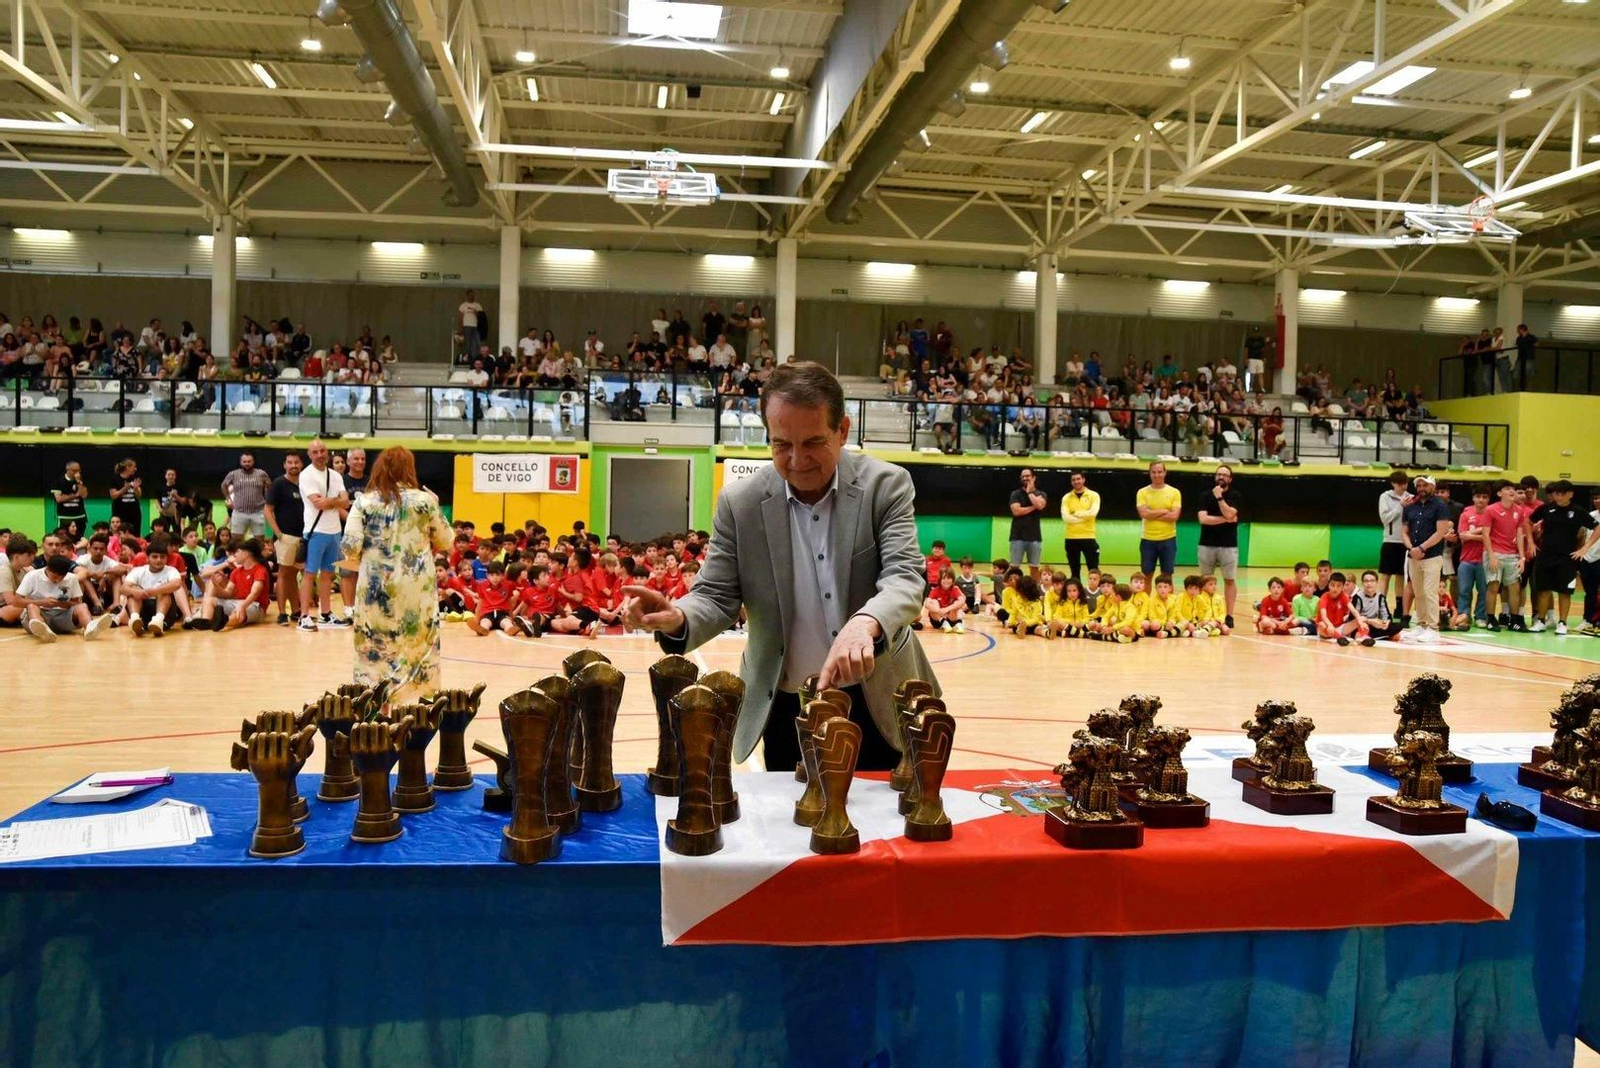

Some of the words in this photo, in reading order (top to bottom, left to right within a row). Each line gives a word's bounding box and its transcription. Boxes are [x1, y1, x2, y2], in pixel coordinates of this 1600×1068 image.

[481, 462, 539, 472] CONCELLO
[731, 465, 760, 474] CONC
[488, 473, 502, 482] DE
[506, 473, 532, 482] VIGO
